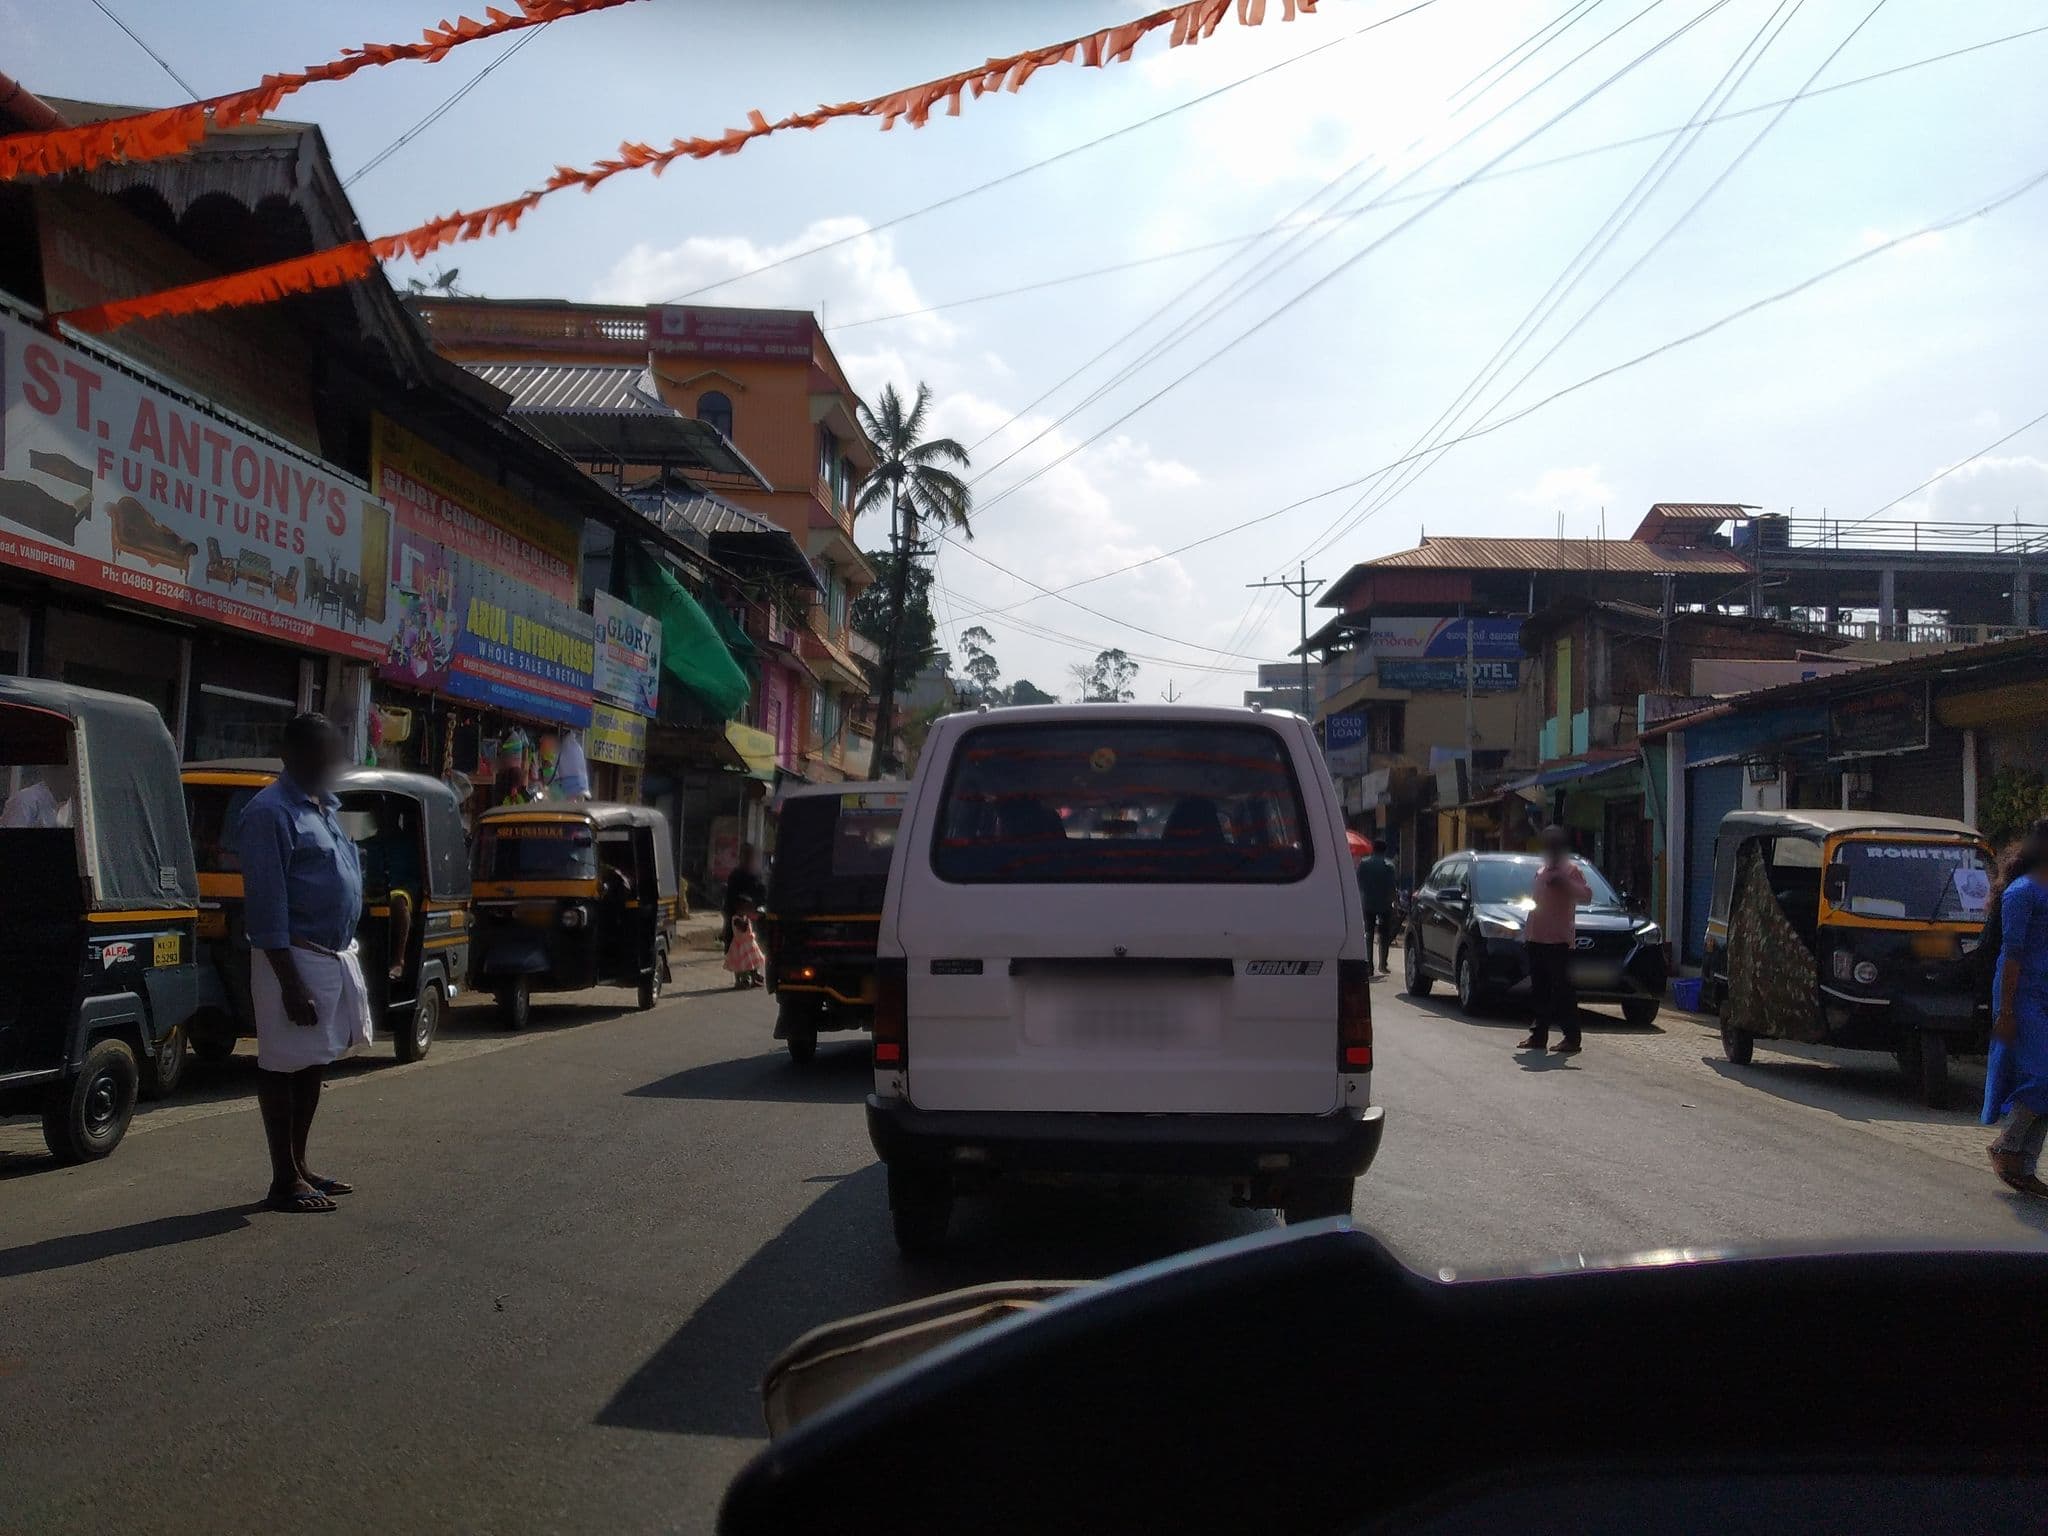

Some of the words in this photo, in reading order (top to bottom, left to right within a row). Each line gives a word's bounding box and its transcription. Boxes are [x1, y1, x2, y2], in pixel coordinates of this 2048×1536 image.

[22, 344, 110, 440] ST.
[129, 396, 347, 537] ANTONY'S
[98, 447, 306, 556] FURNITURES
[383, 468, 437, 514] GLORY
[440, 499, 519, 555] COMPUTER
[19, 545, 76, 571] VANDIPERIYAR
[102, 565, 119, 583] Ph:
[121, 571, 153, 592] 04869
[467, 597, 509, 646] ARUL
[513, 615, 594, 675] ENTERPRISES
[607, 616, 652, 656] GLORY
[478, 641, 514, 666] WHOLE
[519, 656, 542, 675] SALE
[555, 667, 584, 688] RETAIL
[1456, 663, 1513, 679] HOTEL
[1332, 717, 1361, 727] GOLD
[1332, 727, 1361, 738] LOAN
[105, 946, 128, 957] ALFA
